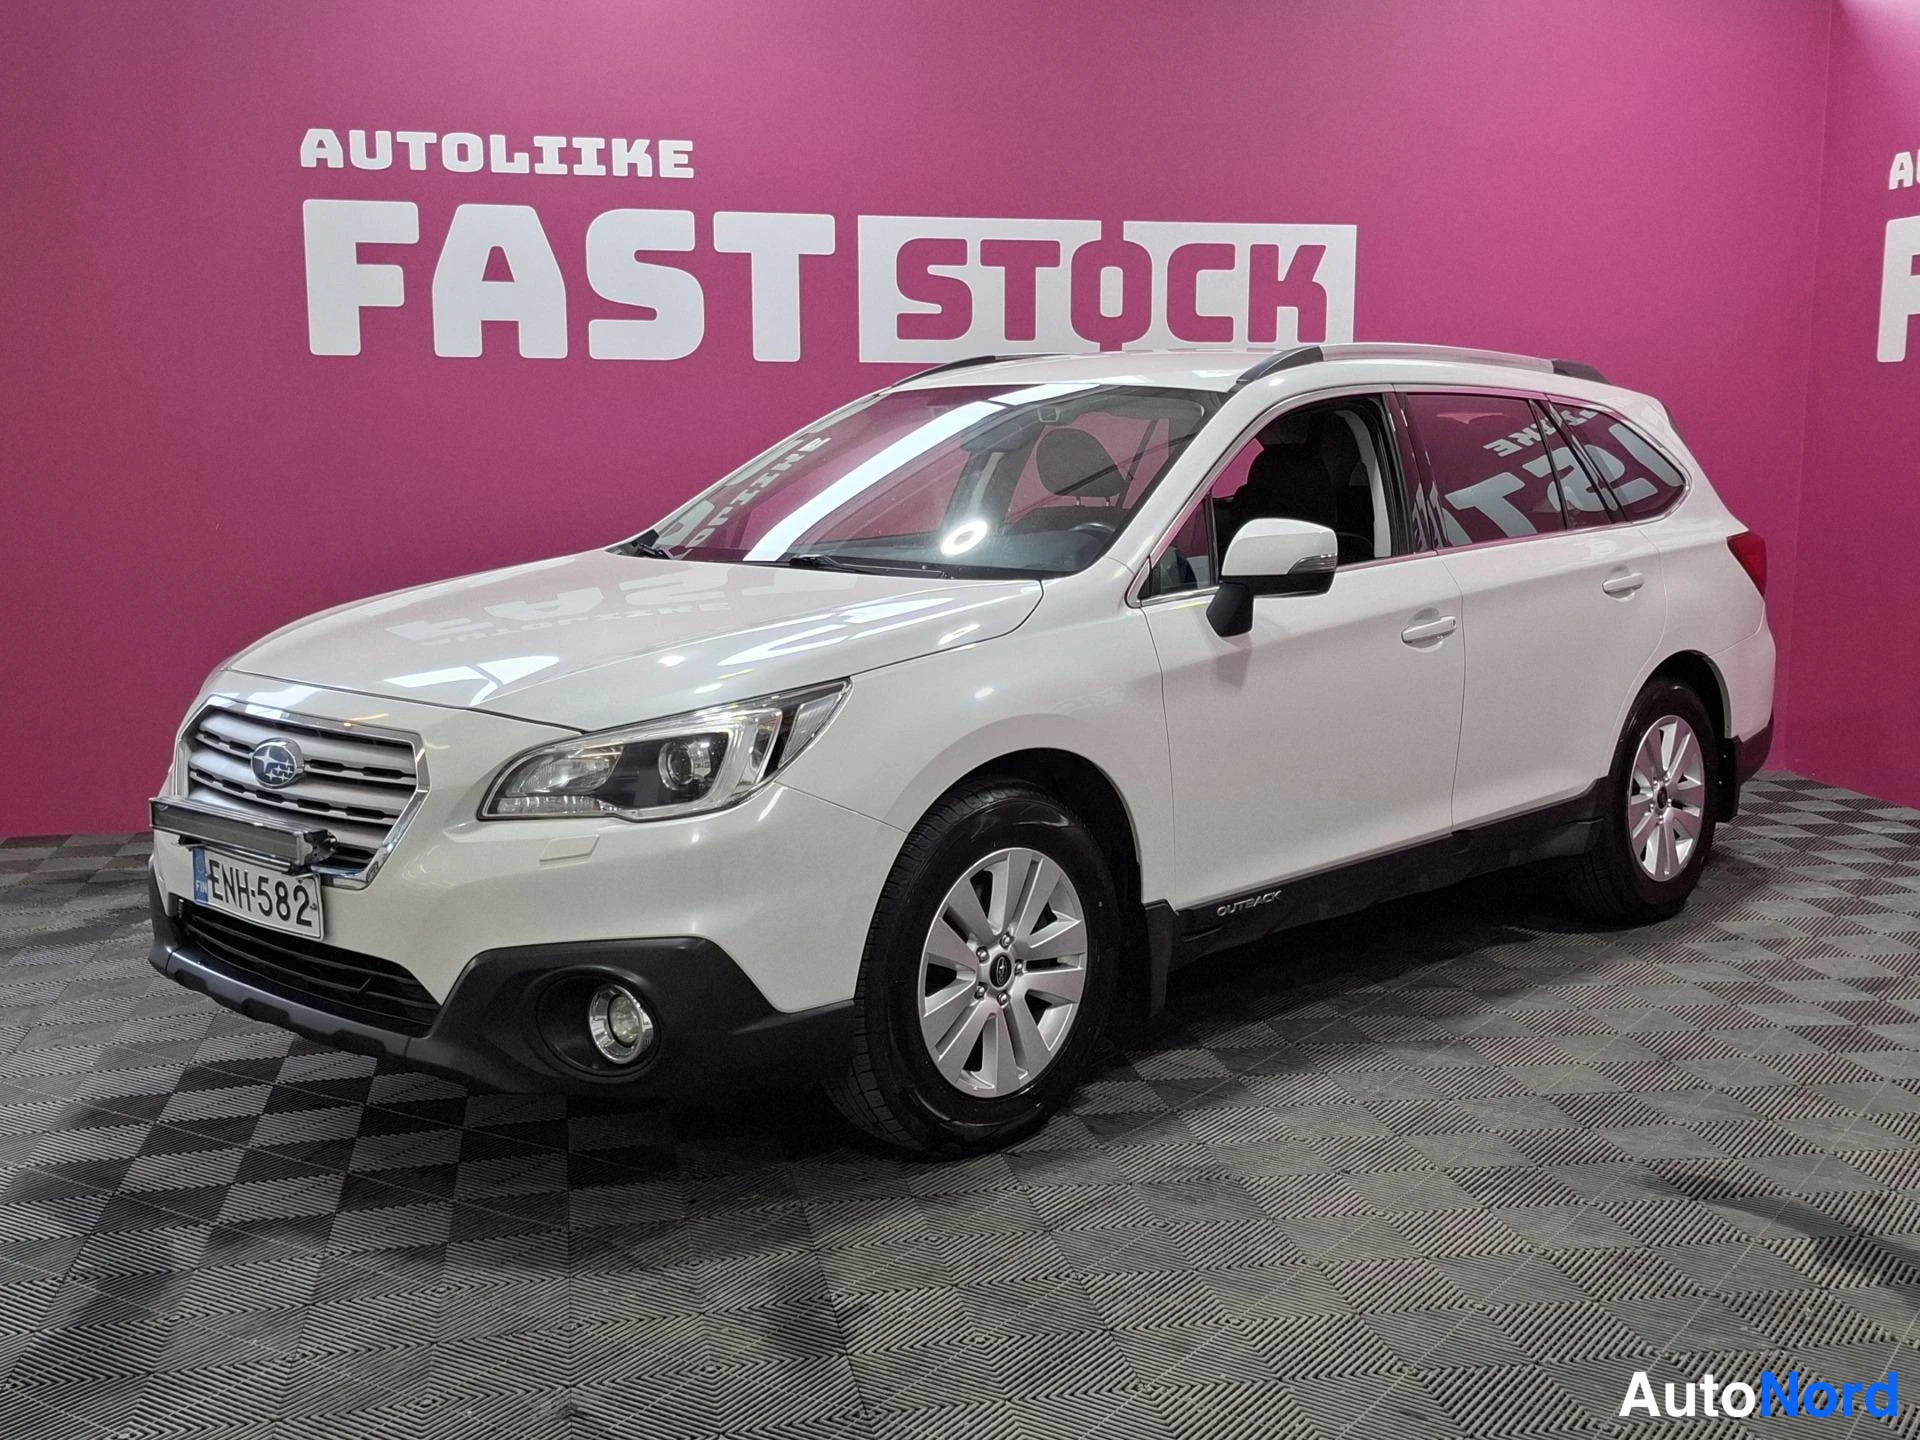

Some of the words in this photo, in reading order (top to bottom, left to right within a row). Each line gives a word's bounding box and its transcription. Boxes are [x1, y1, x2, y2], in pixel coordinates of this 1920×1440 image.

[300, 128, 694, 179] AUTOLIIKE
[303, 199, 836, 362] FAST
[892, 230, 1329, 349] STOCK
[195, 879, 208, 894] FIN
[209, 860, 312, 927] ENH-582
[1216, 889, 1282, 917] OUTBACK
